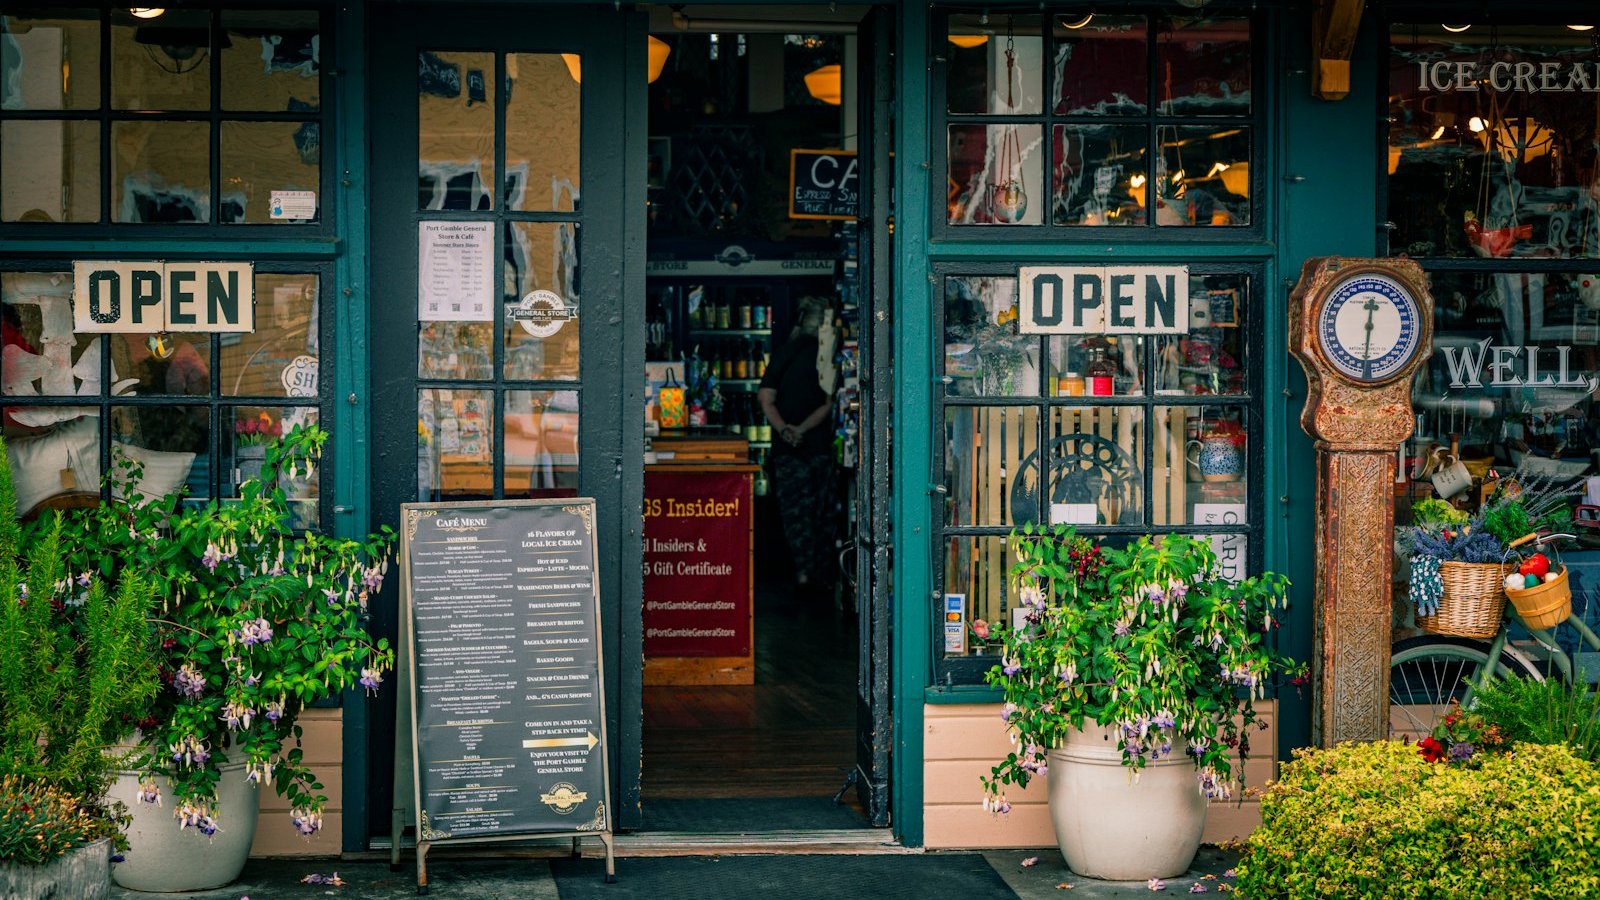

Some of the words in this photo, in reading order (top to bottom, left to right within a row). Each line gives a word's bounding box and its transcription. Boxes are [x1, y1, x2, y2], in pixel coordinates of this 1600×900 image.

[1418, 62, 1479, 92] ICE
[1489, 62, 1600, 94] CREA
[781, 261, 833, 270] GENERAL
[89, 270, 239, 324] OPEN
[1033, 274, 1177, 328] OPEN
[1441, 336, 1599, 393] WELL,
[666, 498, 739, 517] Insider!
[436, 517, 460, 527] CAFÉ
[461, 518, 487, 526] MENU
[653, 538, 695, 552] Insiders
[697, 538, 707, 552] &
[654, 562, 674, 575] Gift
[677, 561, 732, 575] Certificate
[647, 601, 736, 610] @PortGambleGeneralStore
[647, 628, 736, 638] @PortGambleGeneralStore
